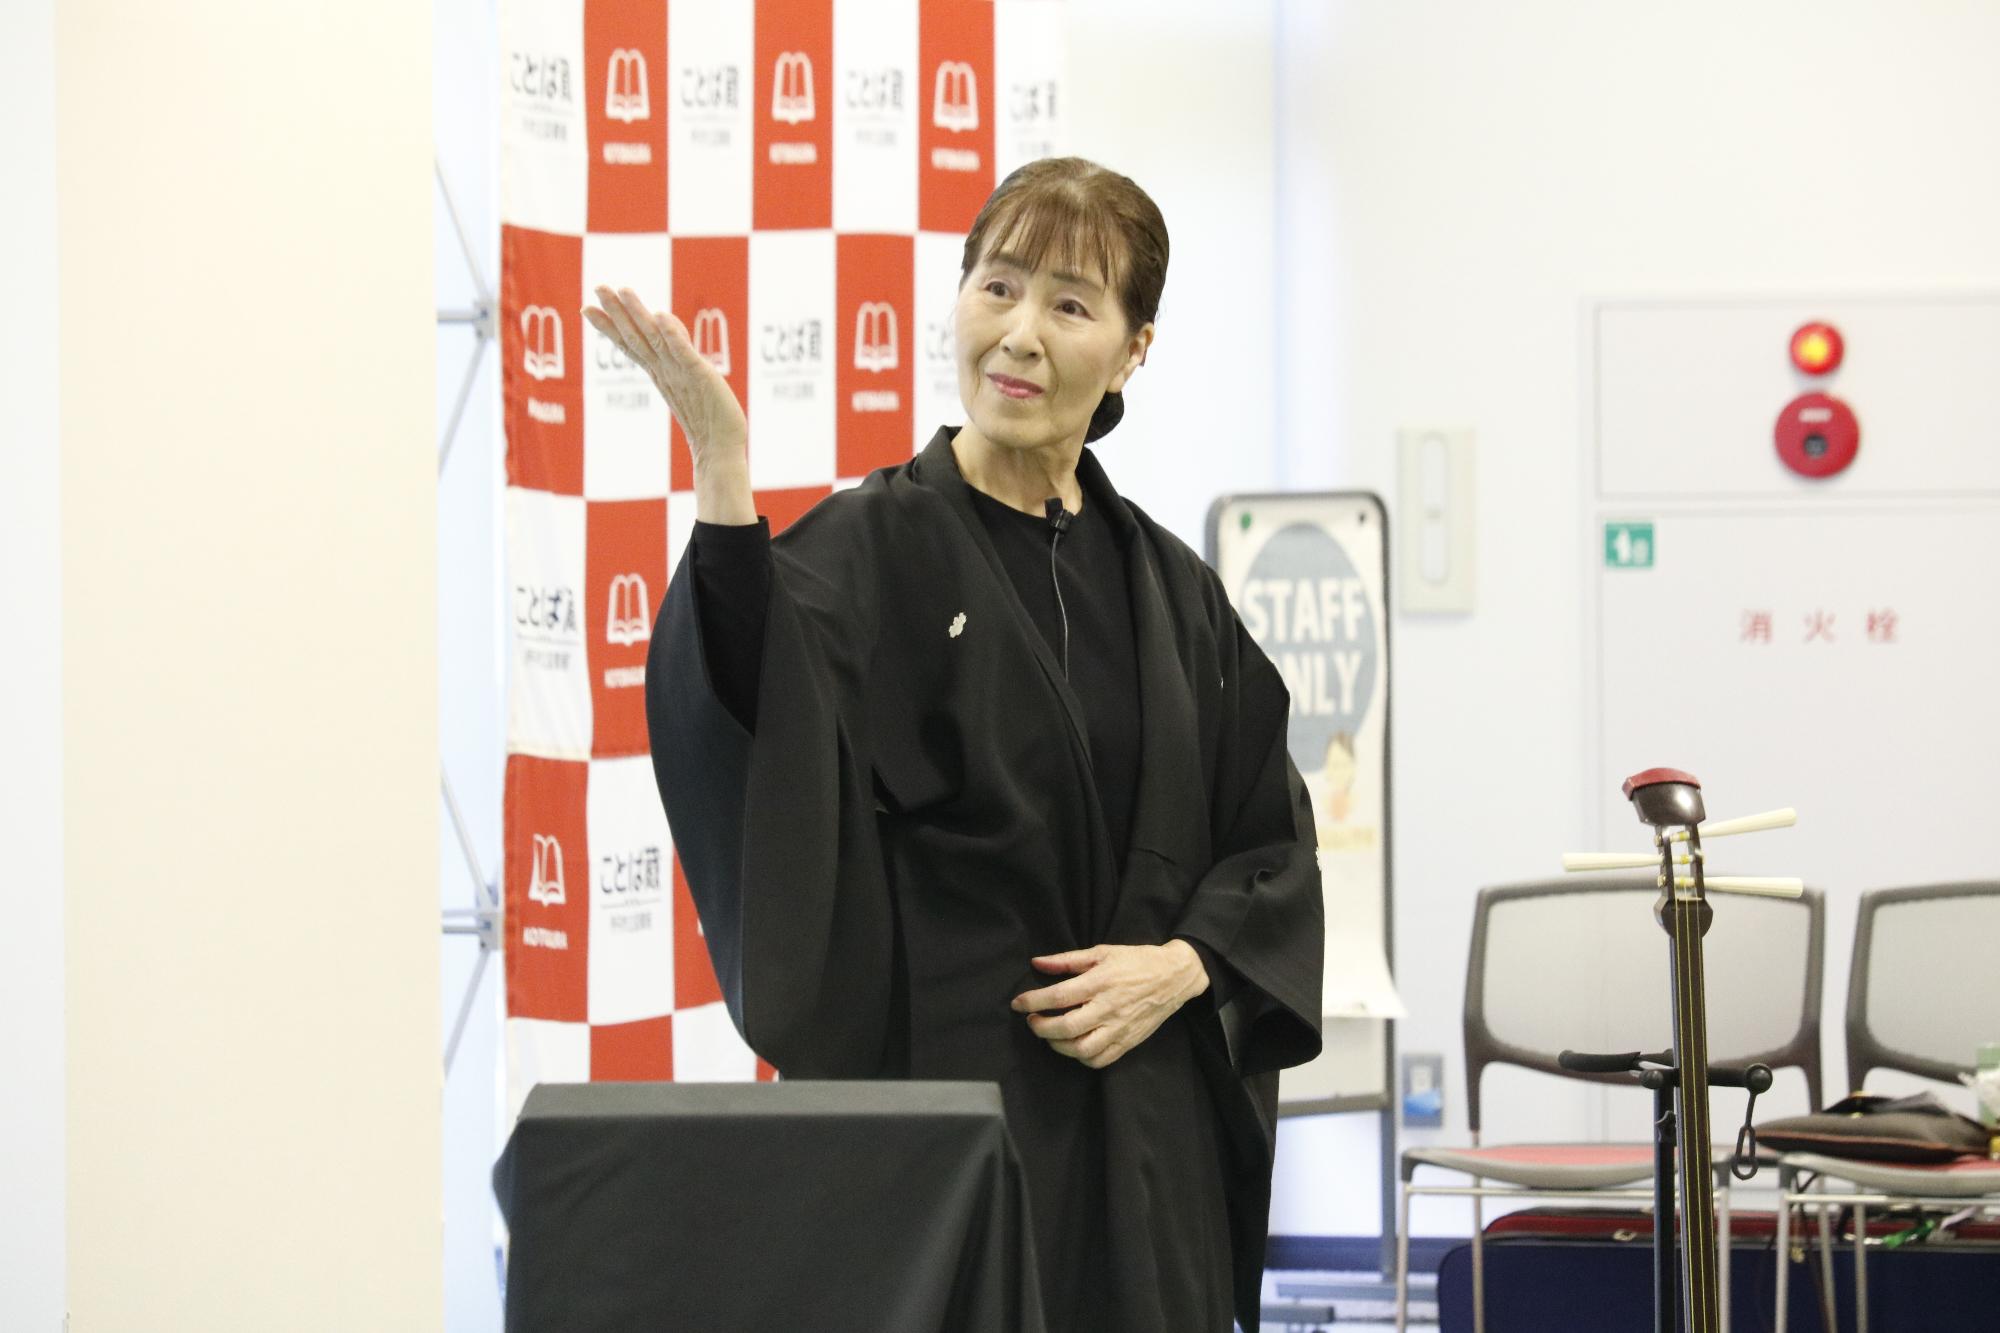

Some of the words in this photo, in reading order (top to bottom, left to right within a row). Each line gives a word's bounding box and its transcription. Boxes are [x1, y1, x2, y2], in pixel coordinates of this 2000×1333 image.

[1243, 577, 1366, 643] STAFF
[1739, 607, 1900, 645] 消火栓
[1273, 651, 1363, 717] NLY
